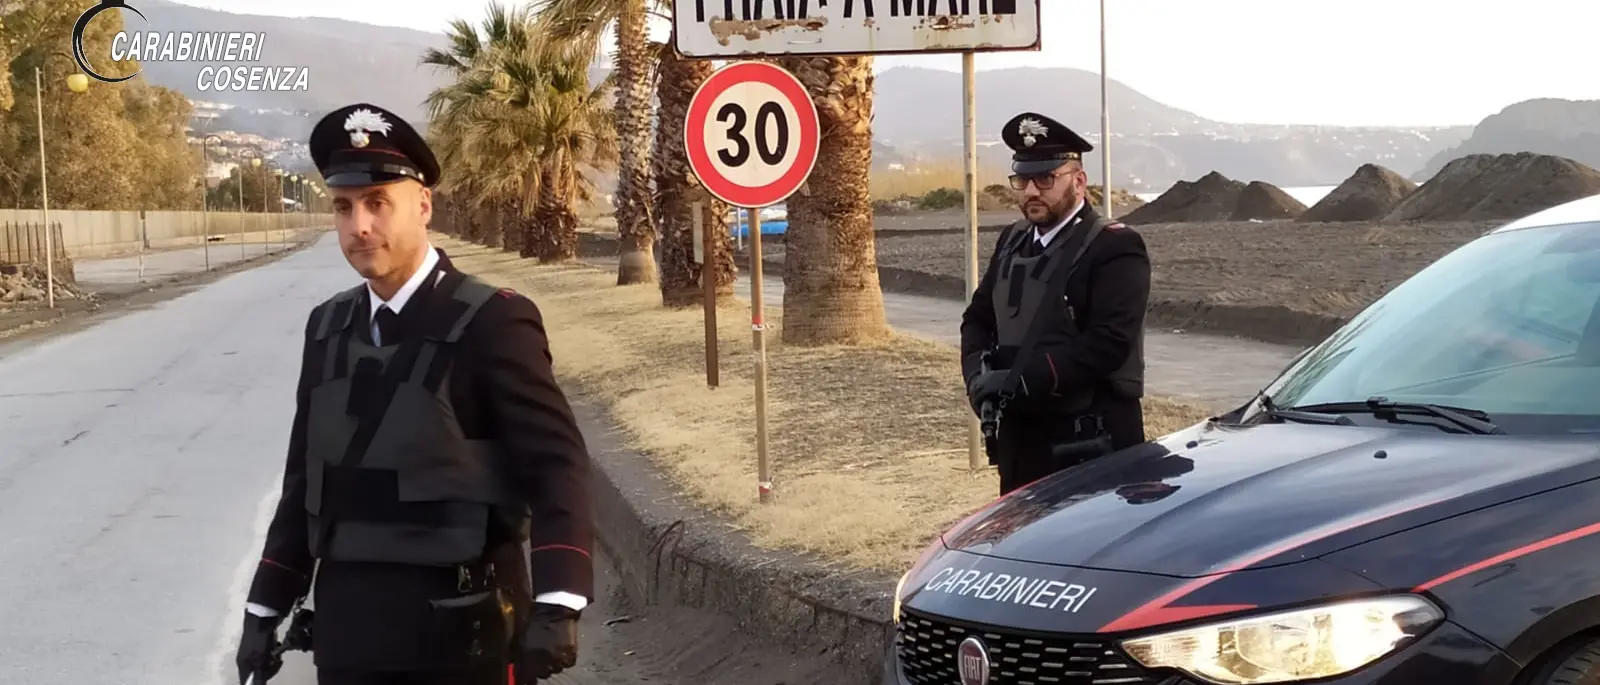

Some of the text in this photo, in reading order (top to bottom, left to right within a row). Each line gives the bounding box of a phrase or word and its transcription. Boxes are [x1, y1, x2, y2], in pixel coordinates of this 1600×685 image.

[716, 101, 789, 168] 30
[925, 567, 1098, 614] CARABINIERI
[963, 654, 982, 681] FIAT
